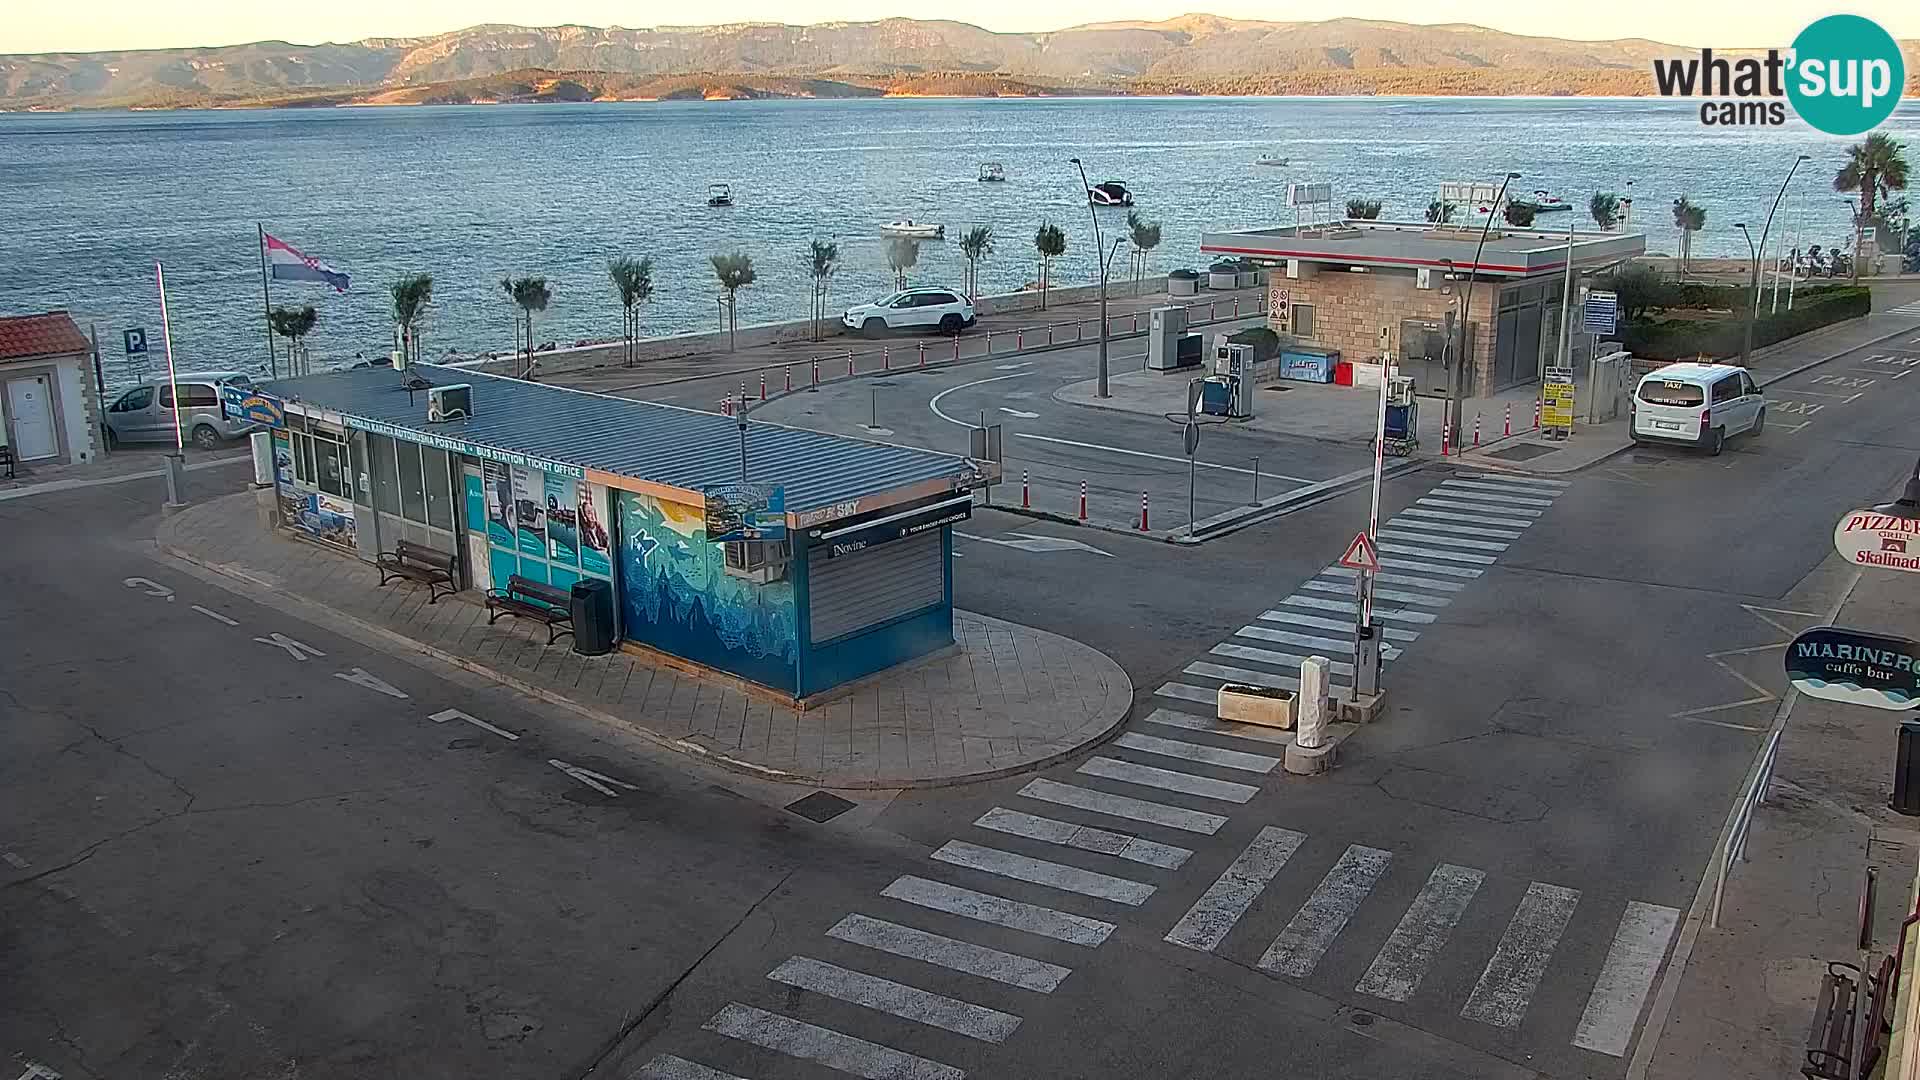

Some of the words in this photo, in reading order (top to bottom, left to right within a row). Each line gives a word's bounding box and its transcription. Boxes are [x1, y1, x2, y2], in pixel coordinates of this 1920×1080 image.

[128, 332, 141, 350] P
[1664, 382, 1682, 390] TAXI
[1810, 375, 1877, 388] TAXI
[435, 438, 466, 453] POSTAJA
[476, 447, 491, 459] BUS
[492, 451, 524, 466] STATION
[527, 457, 553, 471] TICKET
[554, 463, 581, 477] OFFICE
[837, 501, 860, 517] SKY
[1878, 531, 1912, 541] GRILL
[1825, 662, 1862, 676] caffe
[1867, 666, 1894, 681] bar
